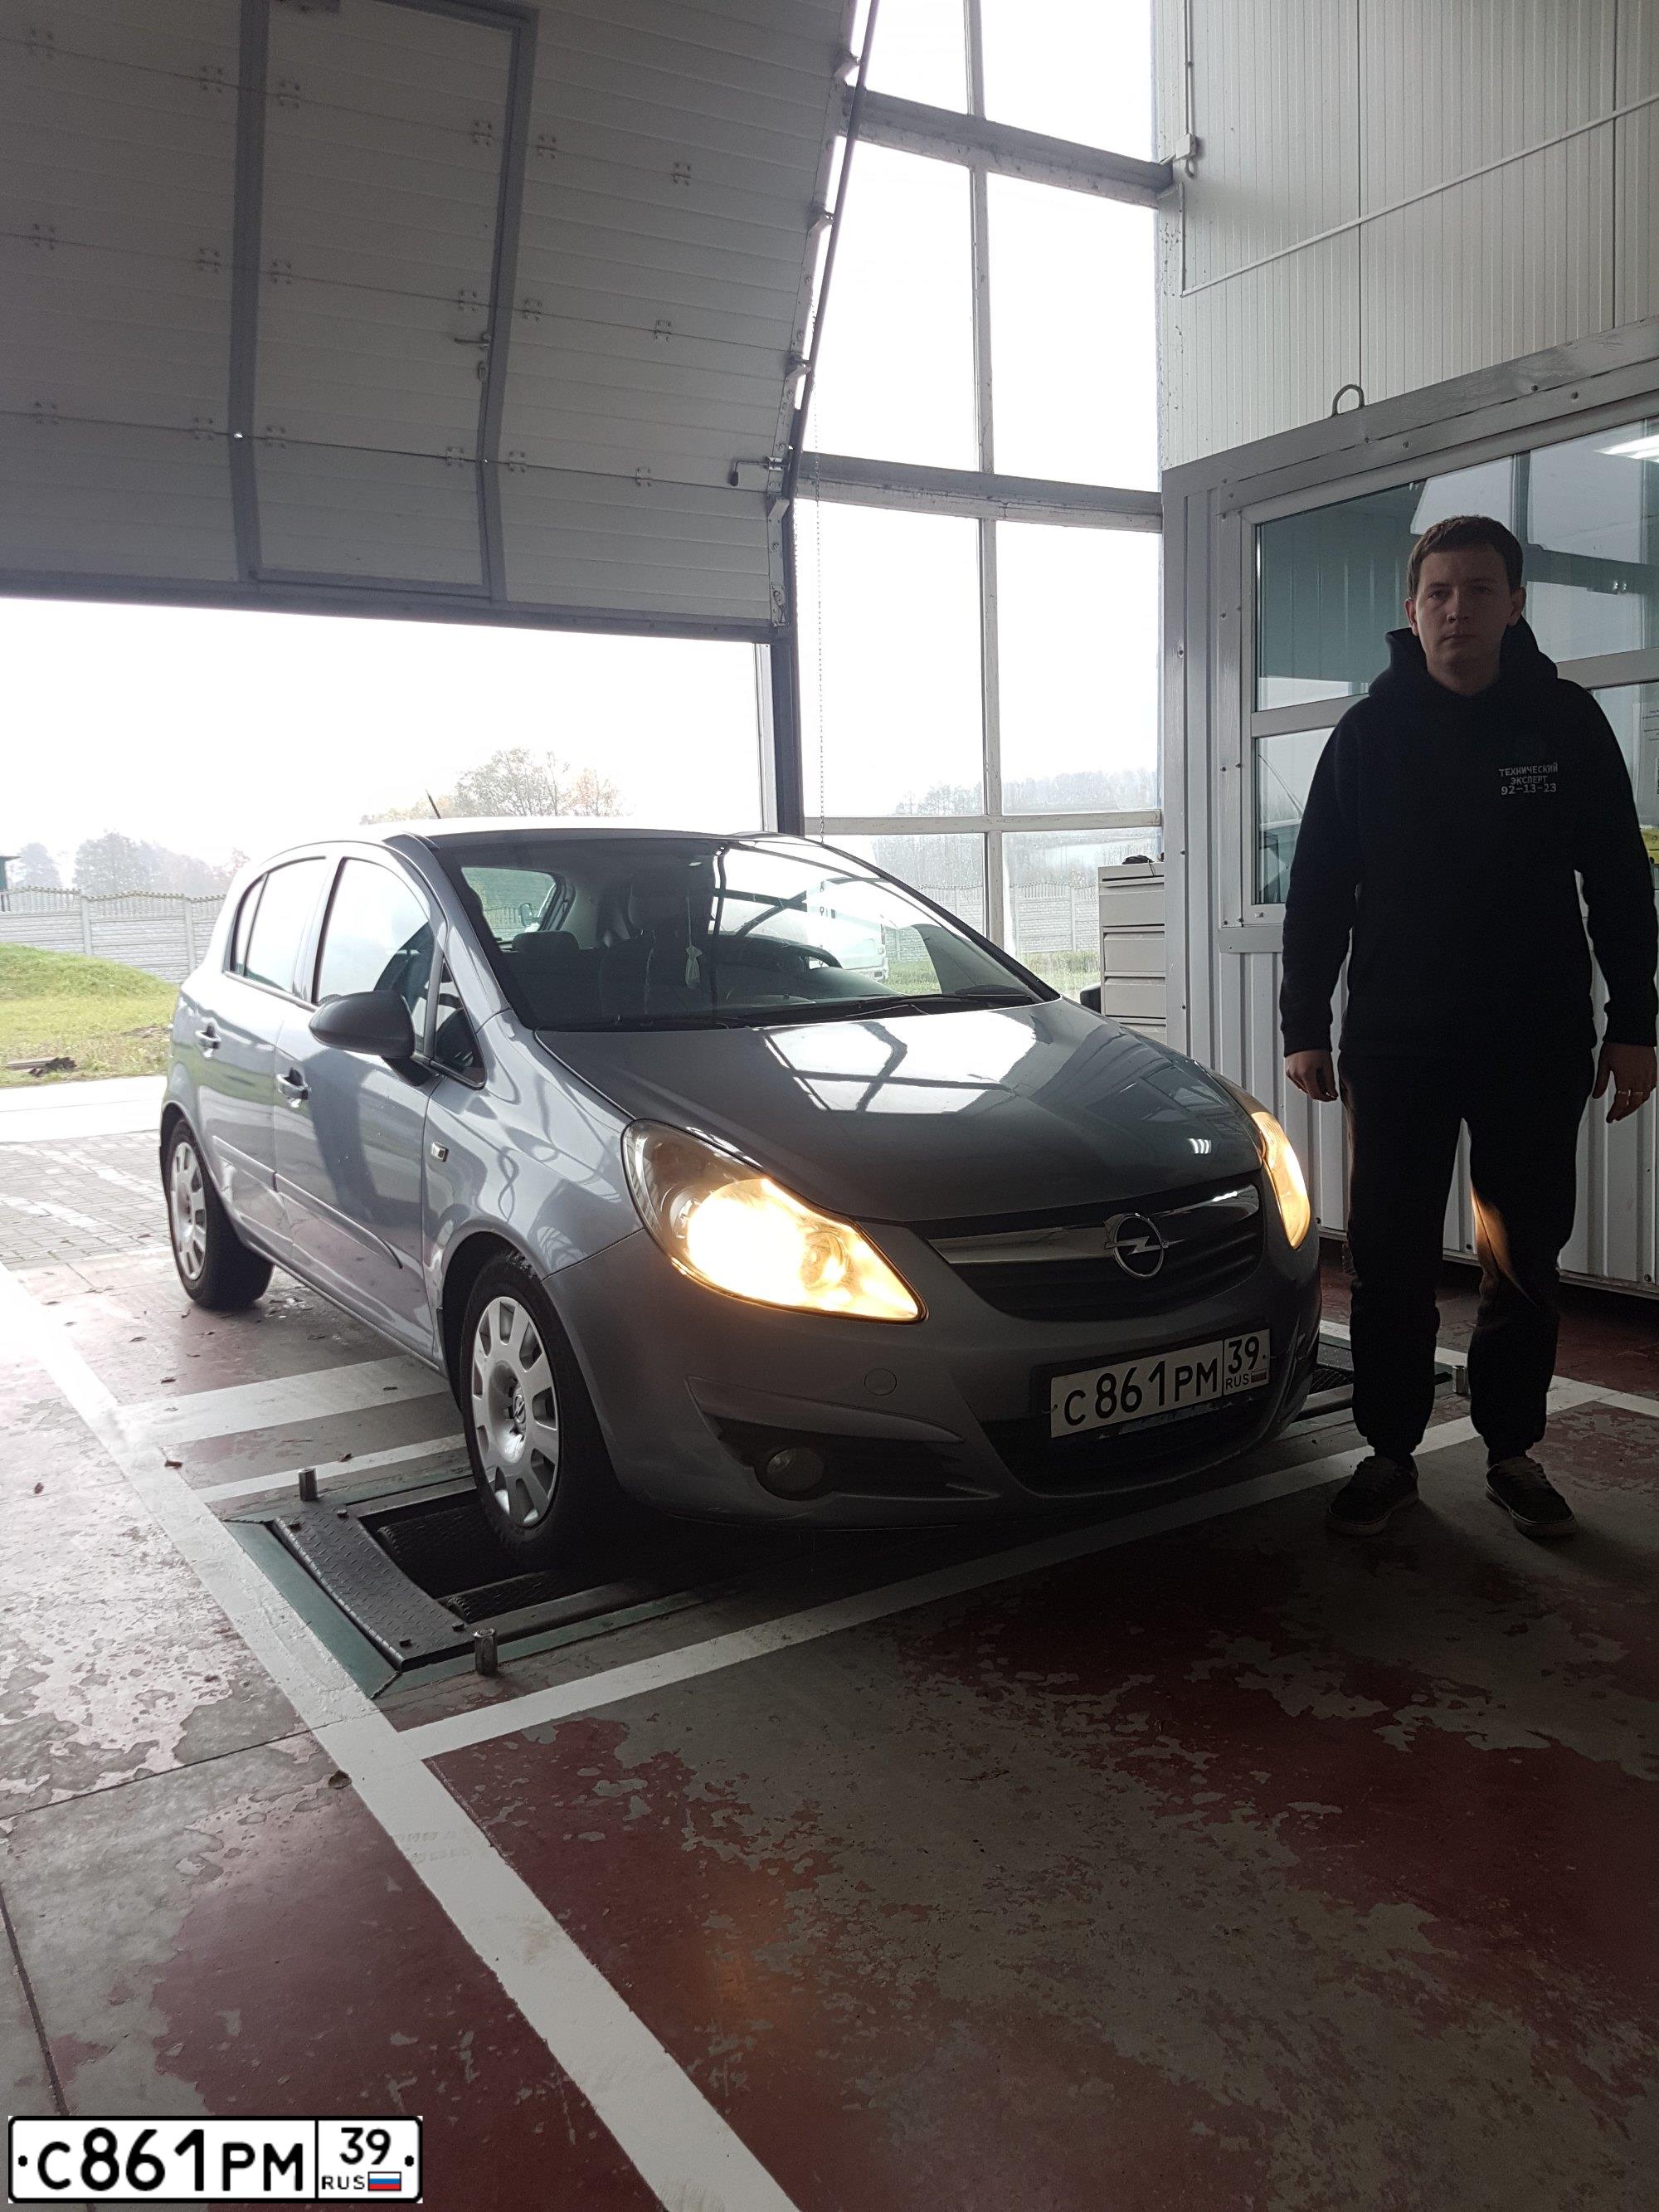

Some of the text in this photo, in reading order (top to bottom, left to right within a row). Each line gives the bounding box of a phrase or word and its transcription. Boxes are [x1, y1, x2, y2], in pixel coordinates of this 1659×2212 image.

[1498, 762, 1559, 777] ТЕХНИЧЕСКИЙ
[1510, 775, 1549, 786] ЭКСПЕРТ
[1501, 782, 1557, 796] 92-13-23
[1228, 1336, 1260, 1374] 39
[1225, 1373, 1249, 1389] RUS
